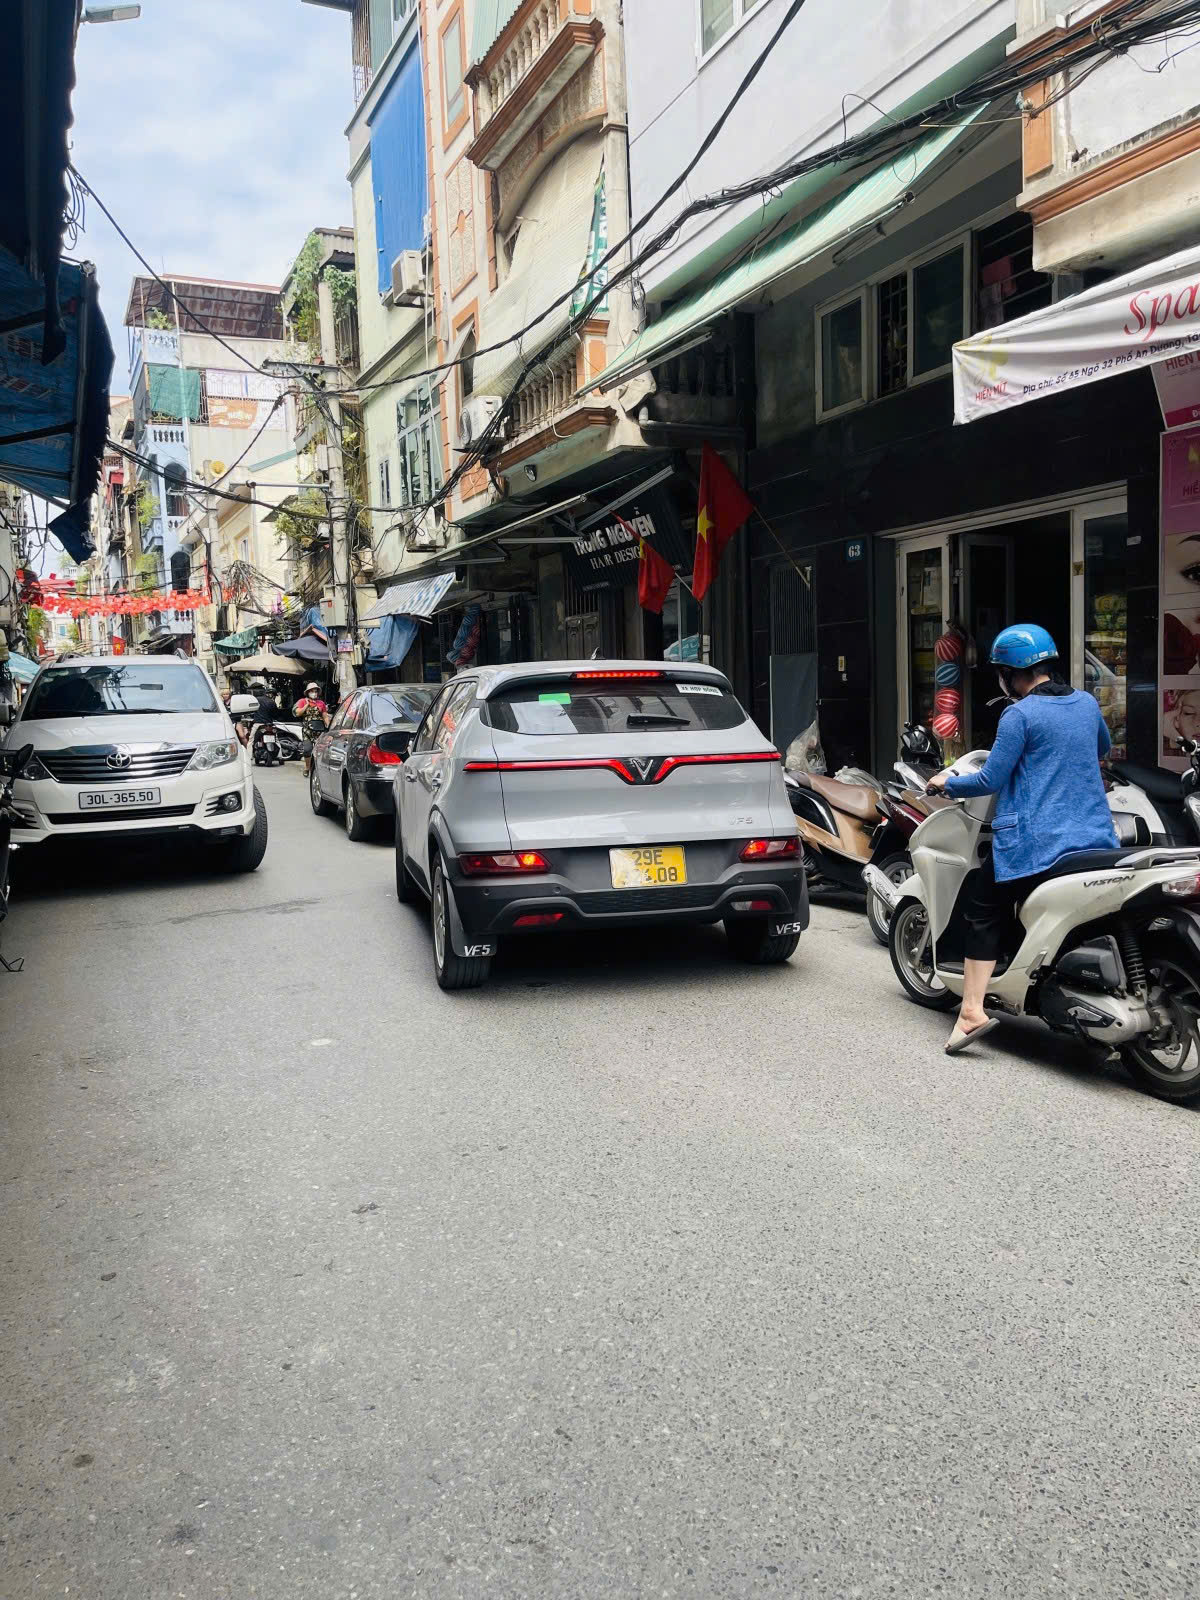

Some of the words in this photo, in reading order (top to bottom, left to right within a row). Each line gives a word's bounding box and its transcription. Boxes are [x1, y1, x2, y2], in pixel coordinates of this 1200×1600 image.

[1124, 282, 1200, 342] Spa
[1102, 360, 1113, 370] 32
[1135, 349, 1148, 360] An
[848, 544, 861, 558] 63
[590, 554, 614, 570] HAIR
[87, 791, 154, 805] 30L-365.50
[632, 849, 664, 866] 29E
[1083, 874, 1136, 888] VISION
